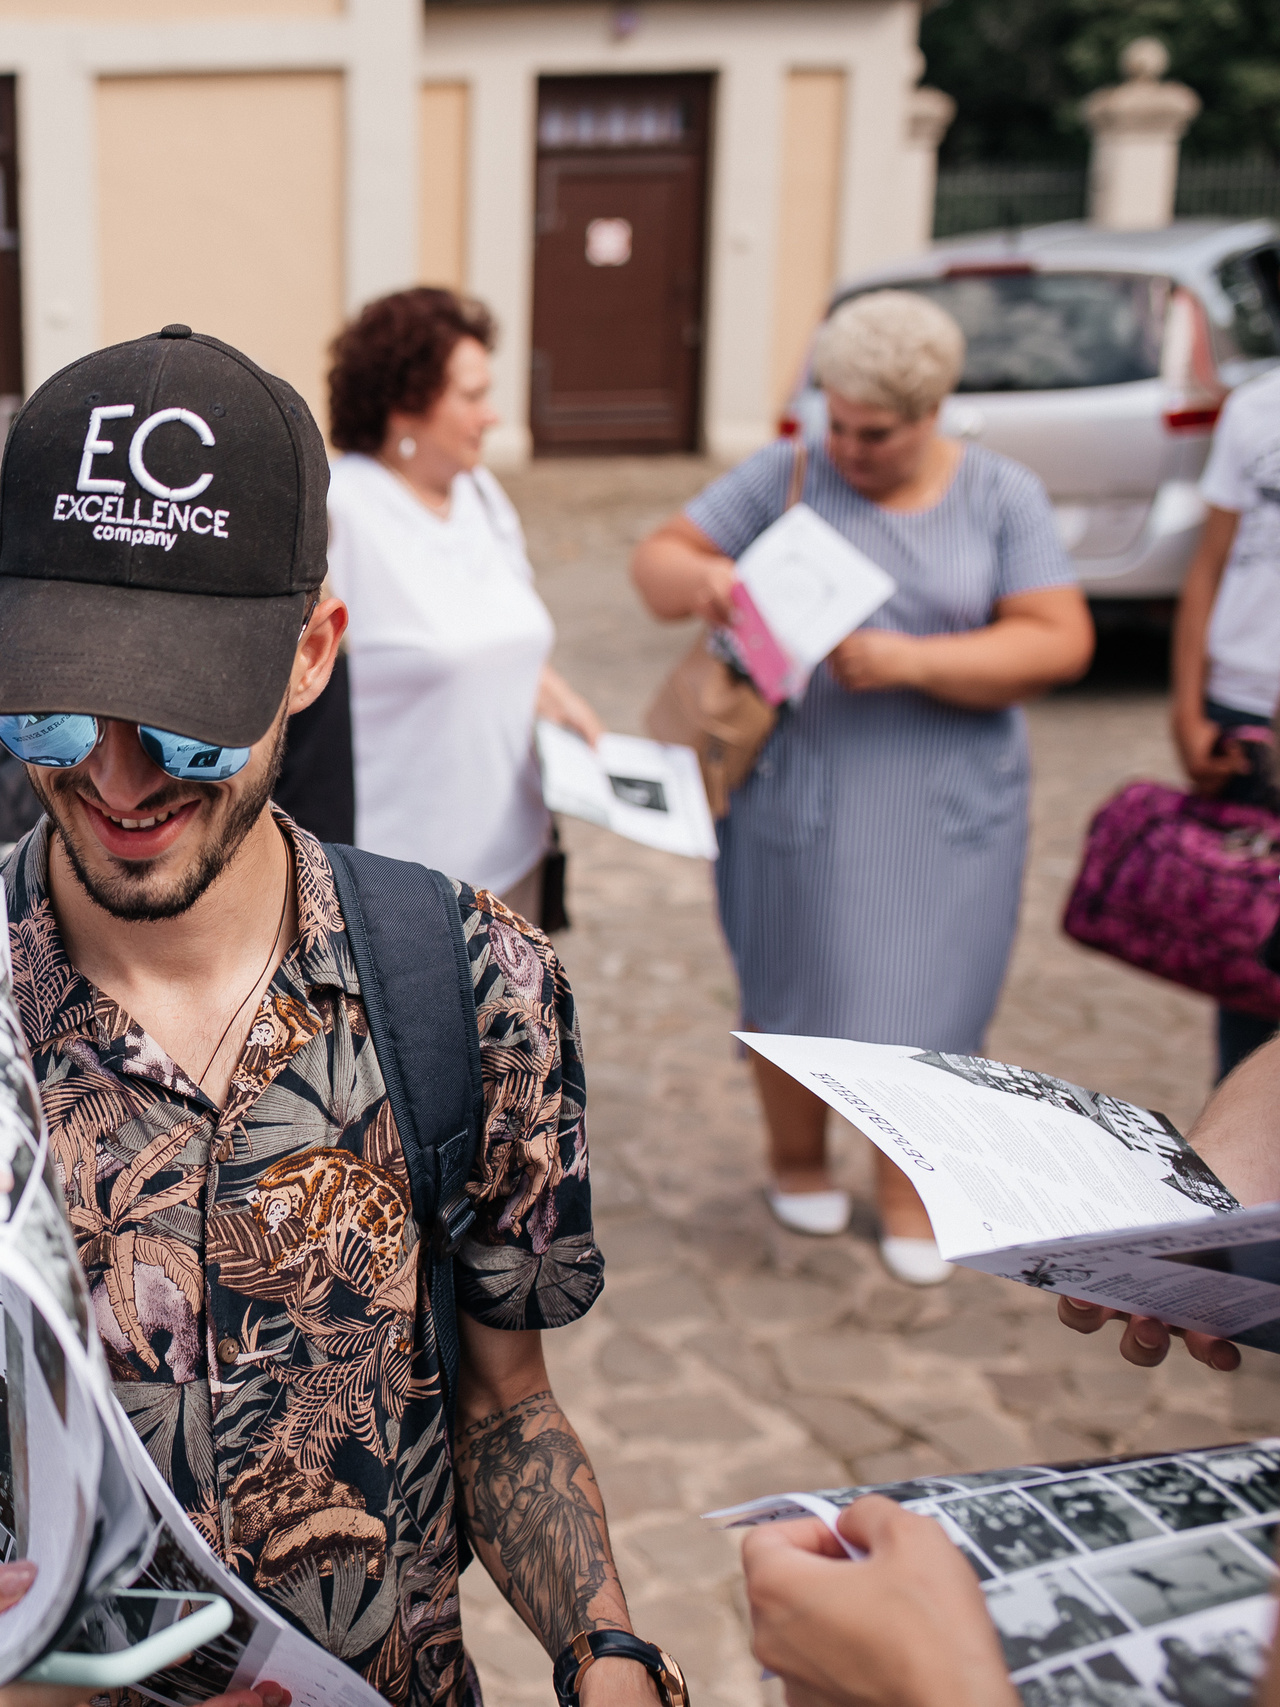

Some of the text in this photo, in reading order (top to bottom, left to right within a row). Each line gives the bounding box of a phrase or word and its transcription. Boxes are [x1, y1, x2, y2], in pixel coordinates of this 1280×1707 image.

[76, 404, 216, 502] EC
[53, 494, 230, 538] EXCELLENCE
[92, 524, 178, 551] company
[809, 1071, 935, 1171] ОБЪЯВЛЕНИЯ
